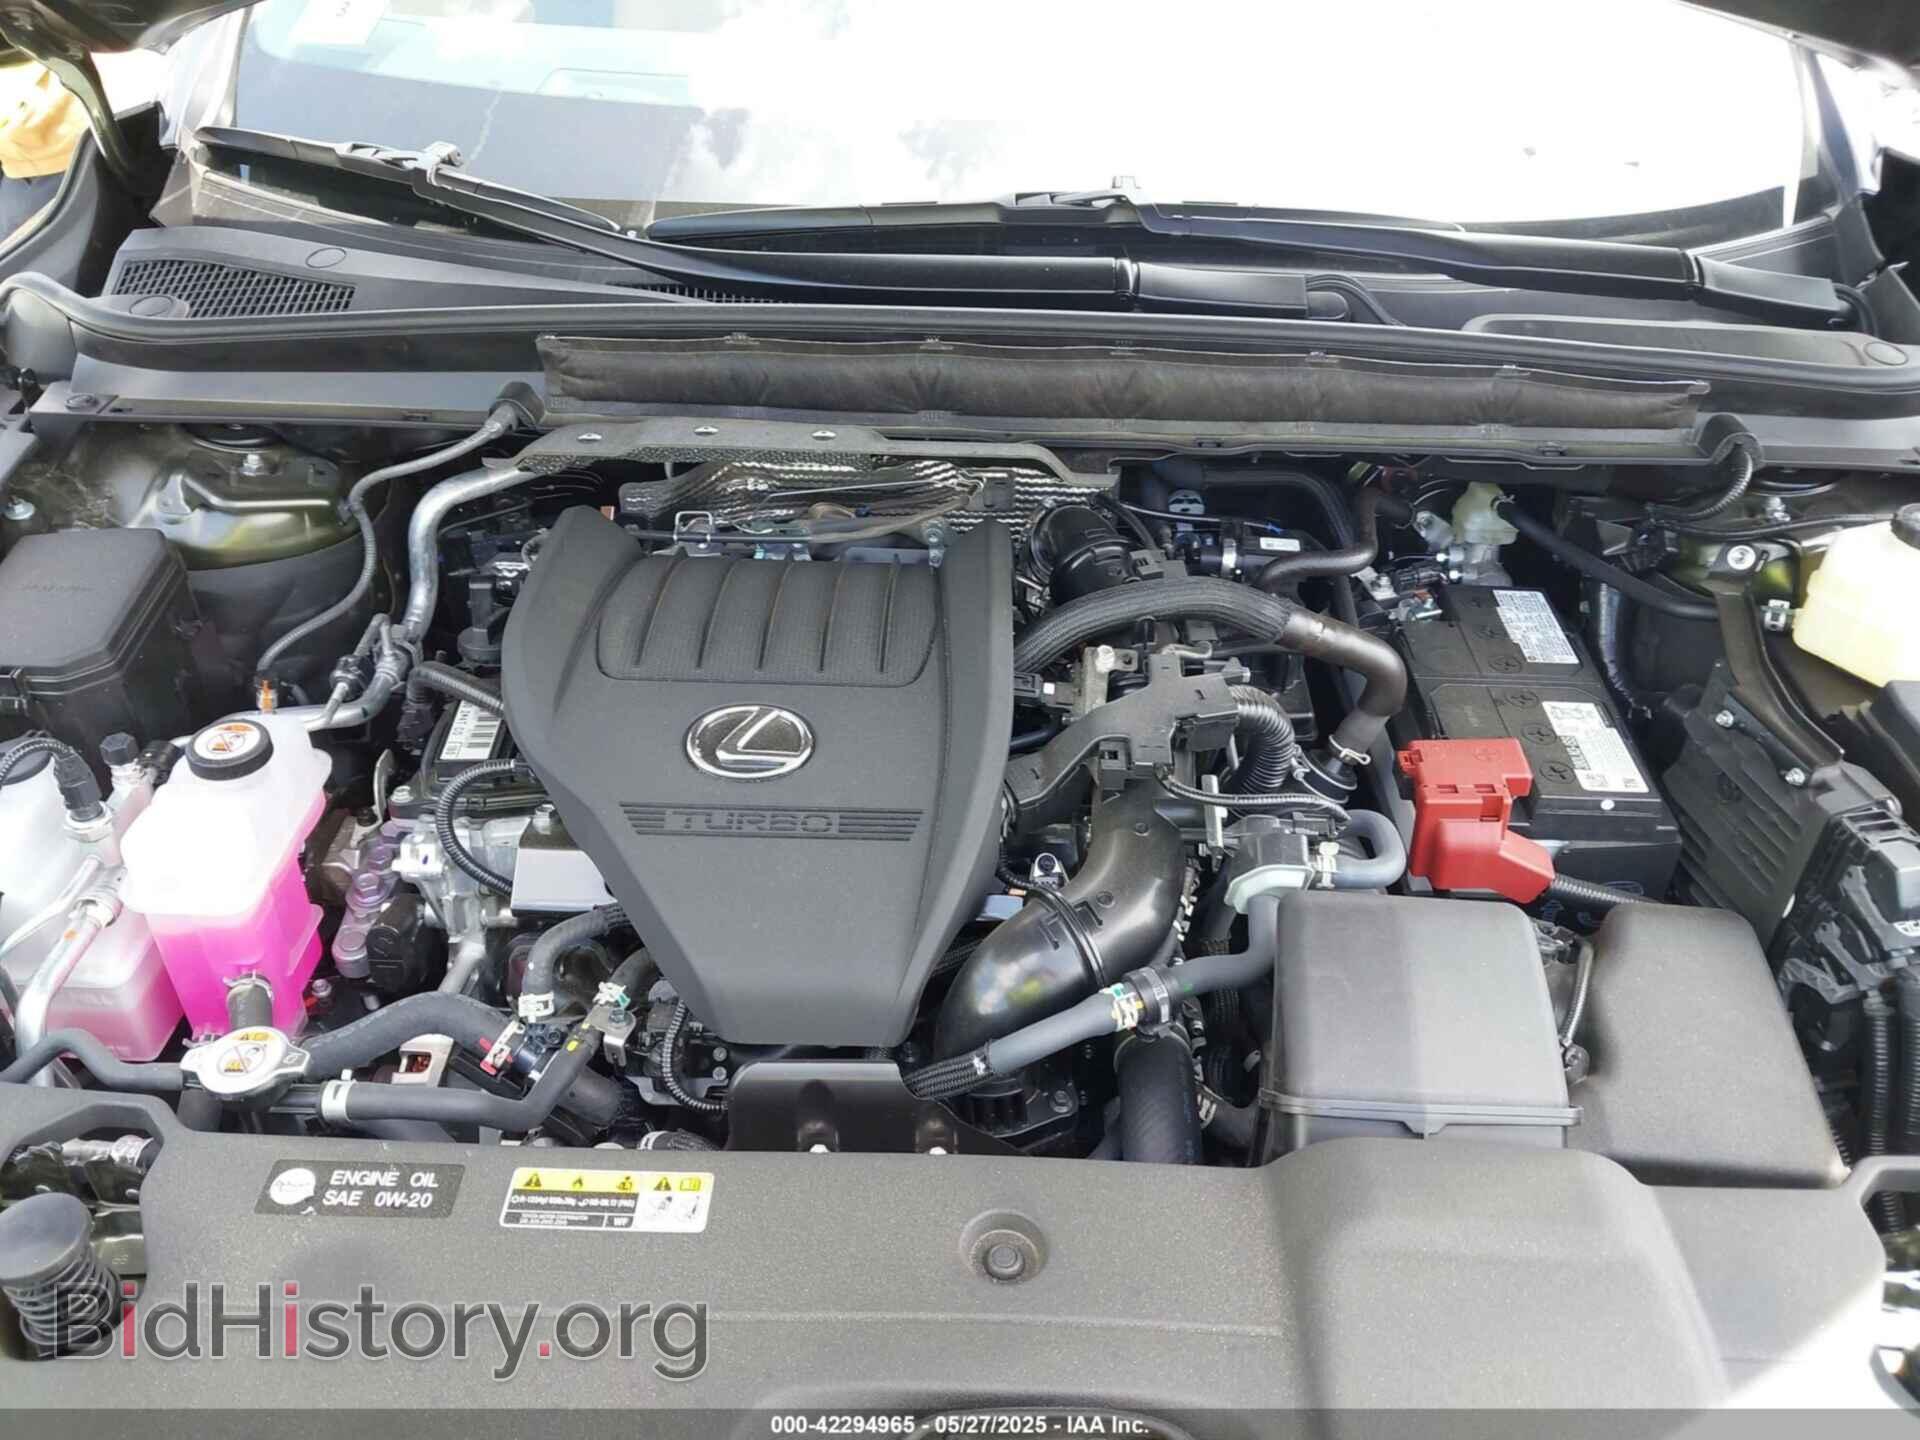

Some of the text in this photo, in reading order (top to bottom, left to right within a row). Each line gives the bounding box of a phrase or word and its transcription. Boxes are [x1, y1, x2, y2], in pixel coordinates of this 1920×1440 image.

[671, 810, 833, 833] TURBO
[329, 1170, 400, 1187] ENGINE
[410, 1172, 439, 1188] OIL
[322, 1190, 434, 1208] SAE 0W-20
